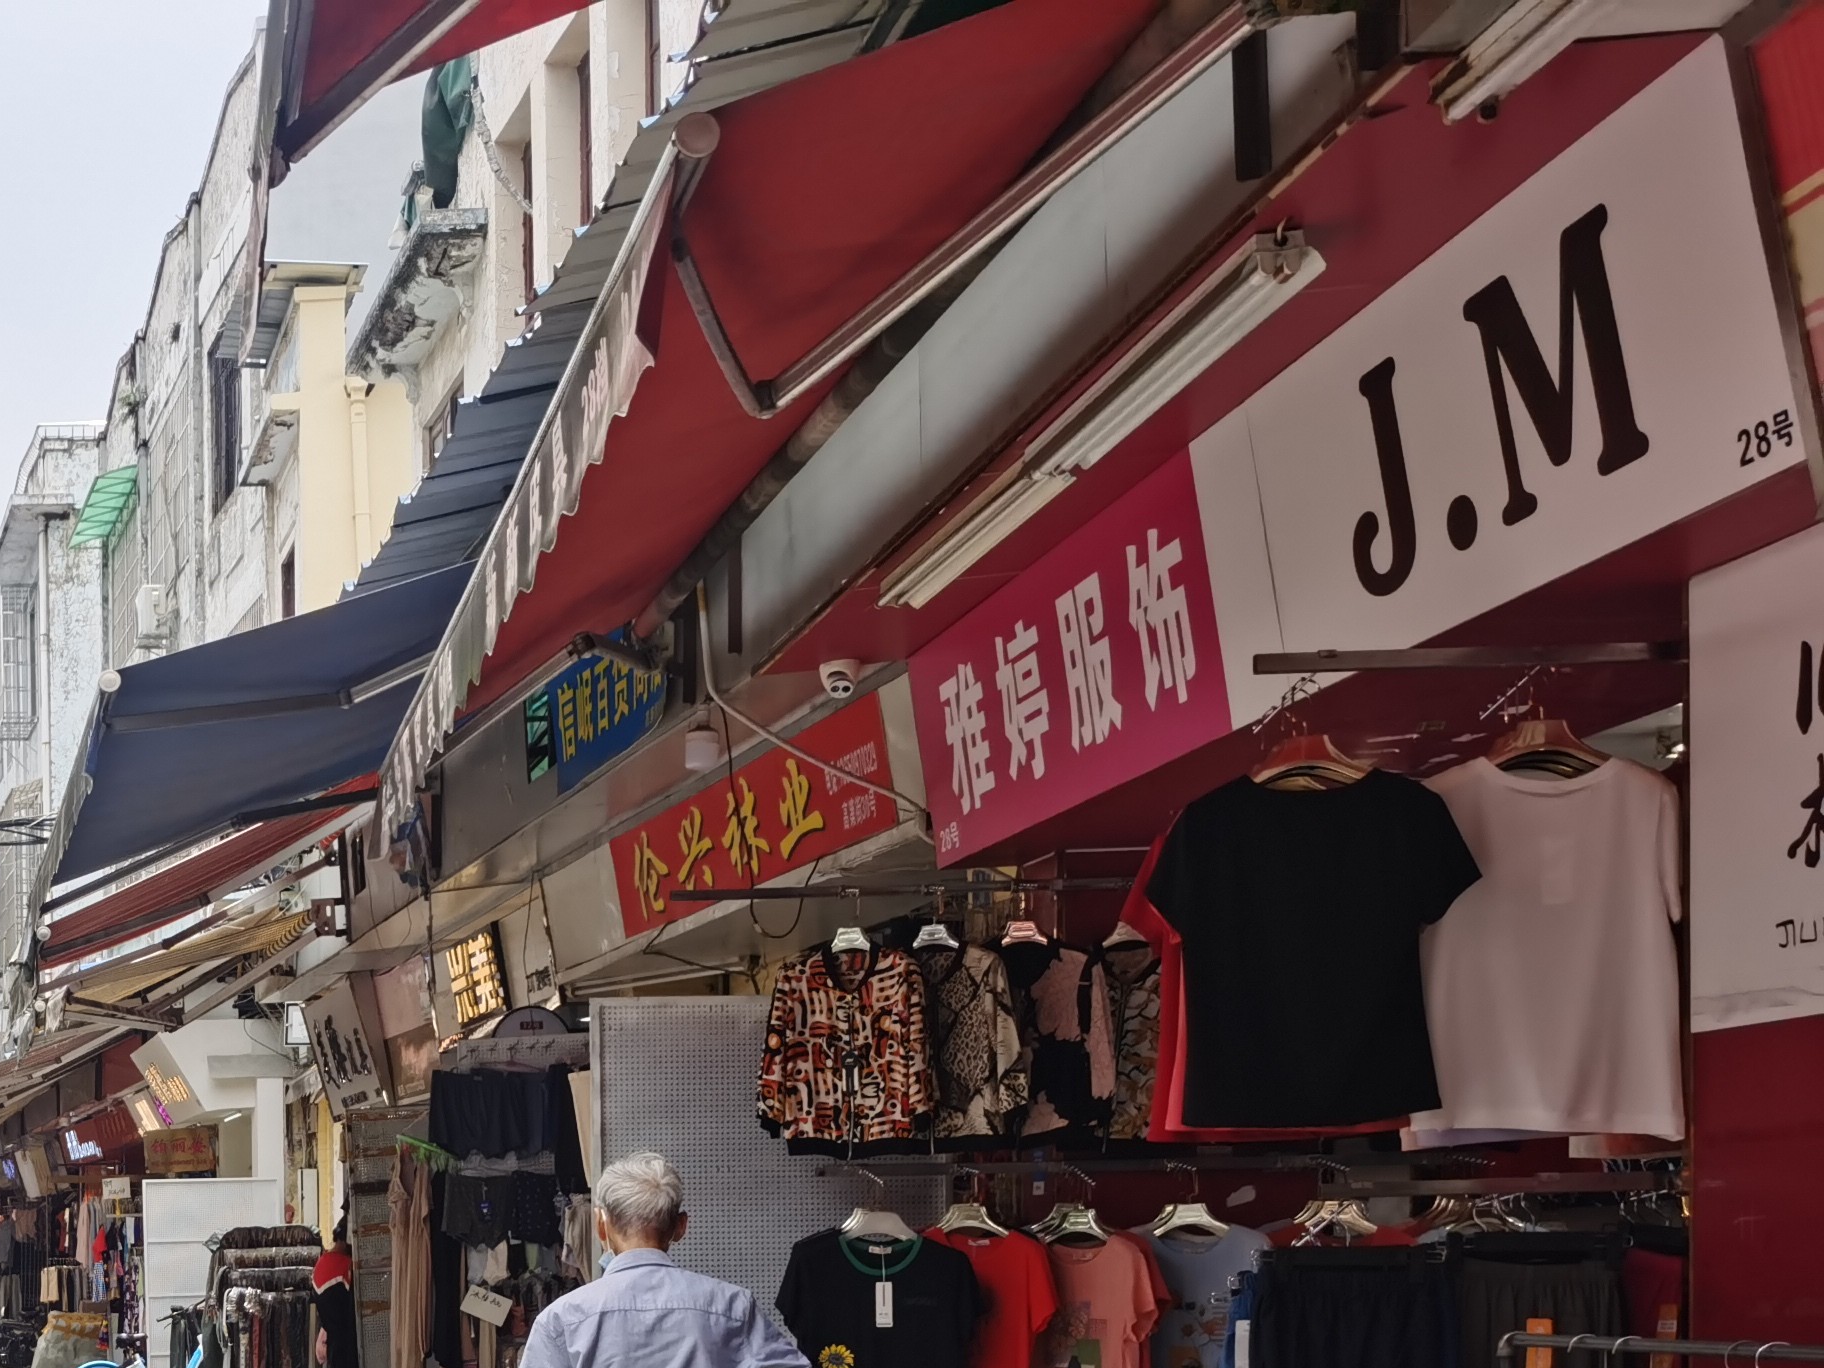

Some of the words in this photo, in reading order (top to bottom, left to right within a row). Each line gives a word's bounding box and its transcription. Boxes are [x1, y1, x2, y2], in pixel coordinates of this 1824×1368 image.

[1353, 203, 1650, 597] J.M
[1737, 408, 1794, 467] 28号
[938, 528, 1198, 816] 雅婷服饰
[939, 821, 960, 853] 28号
